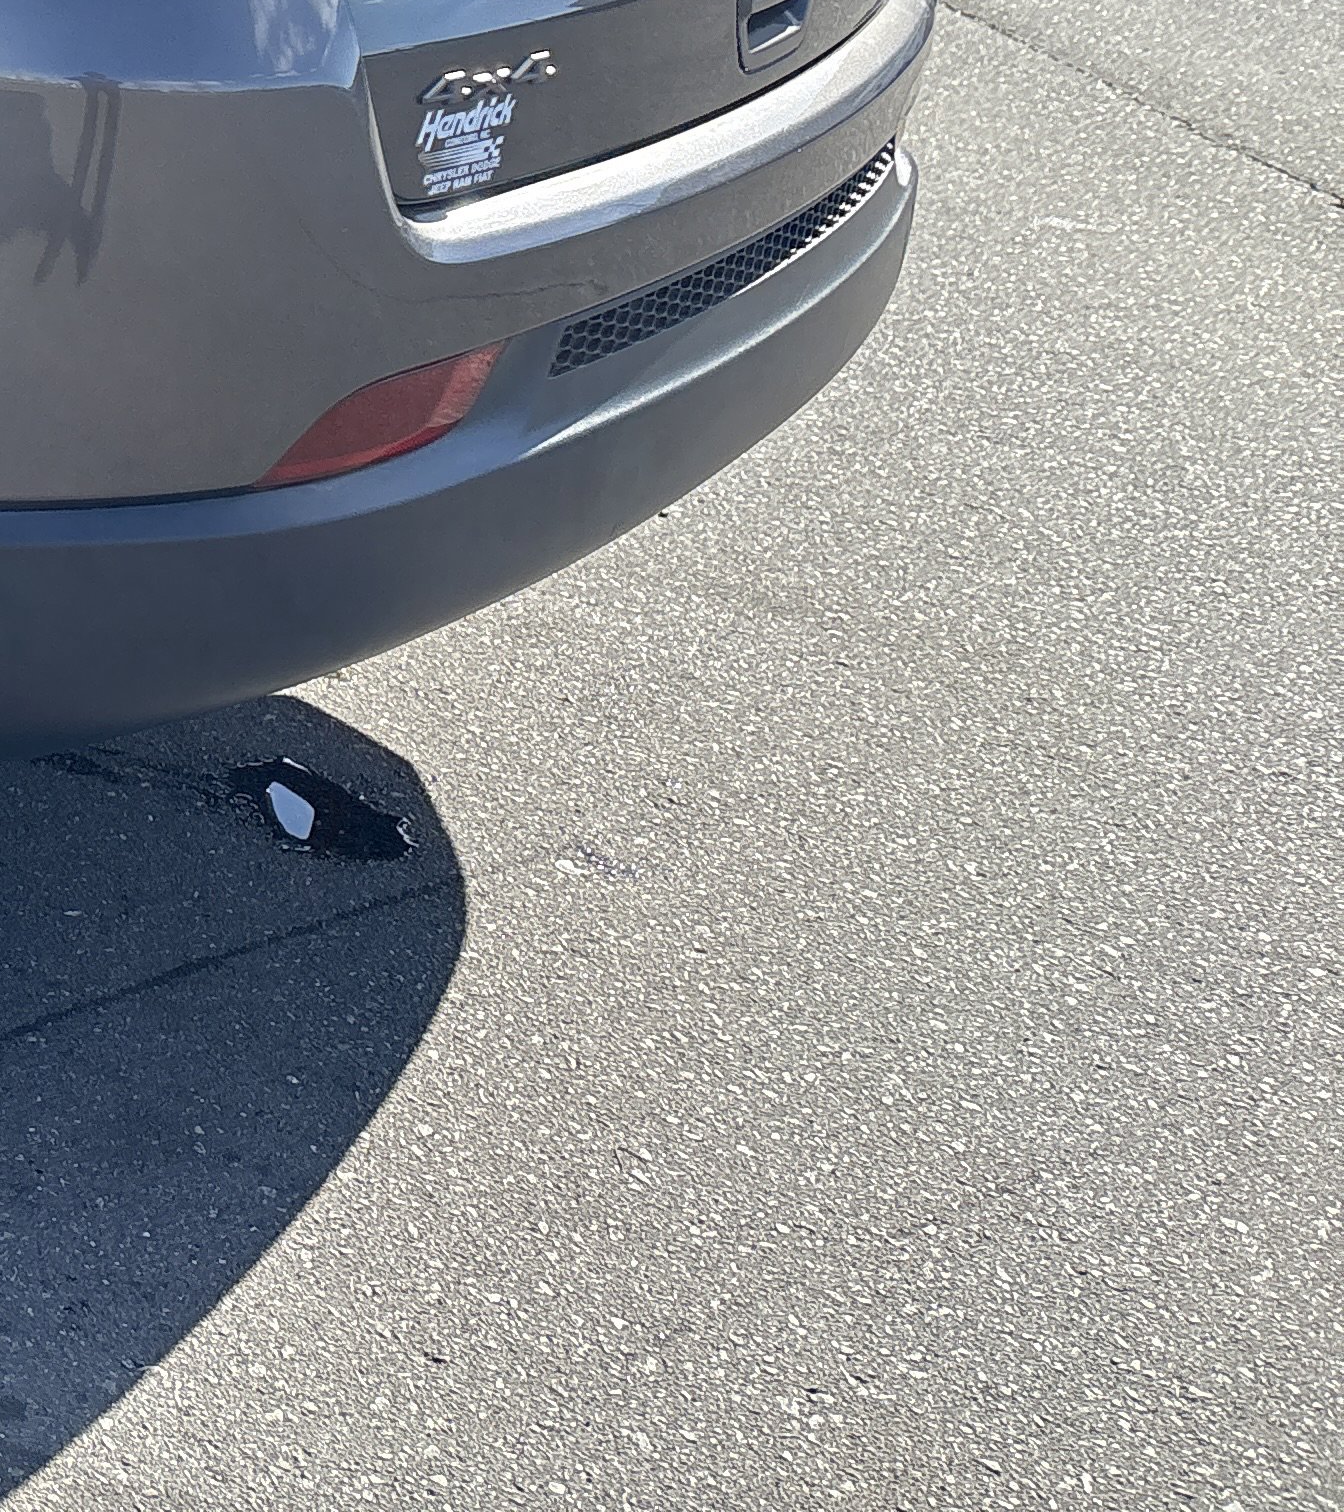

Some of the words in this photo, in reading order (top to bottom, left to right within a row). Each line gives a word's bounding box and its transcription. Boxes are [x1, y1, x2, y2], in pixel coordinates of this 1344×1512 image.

[415, 93, 518, 153] Hendrick
[423, 164, 470, 186] CHRYSLER
[470, 156, 502, 174] DODGE
[452, 175, 472, 189] RAM
[473, 169, 495, 184] FIAT
